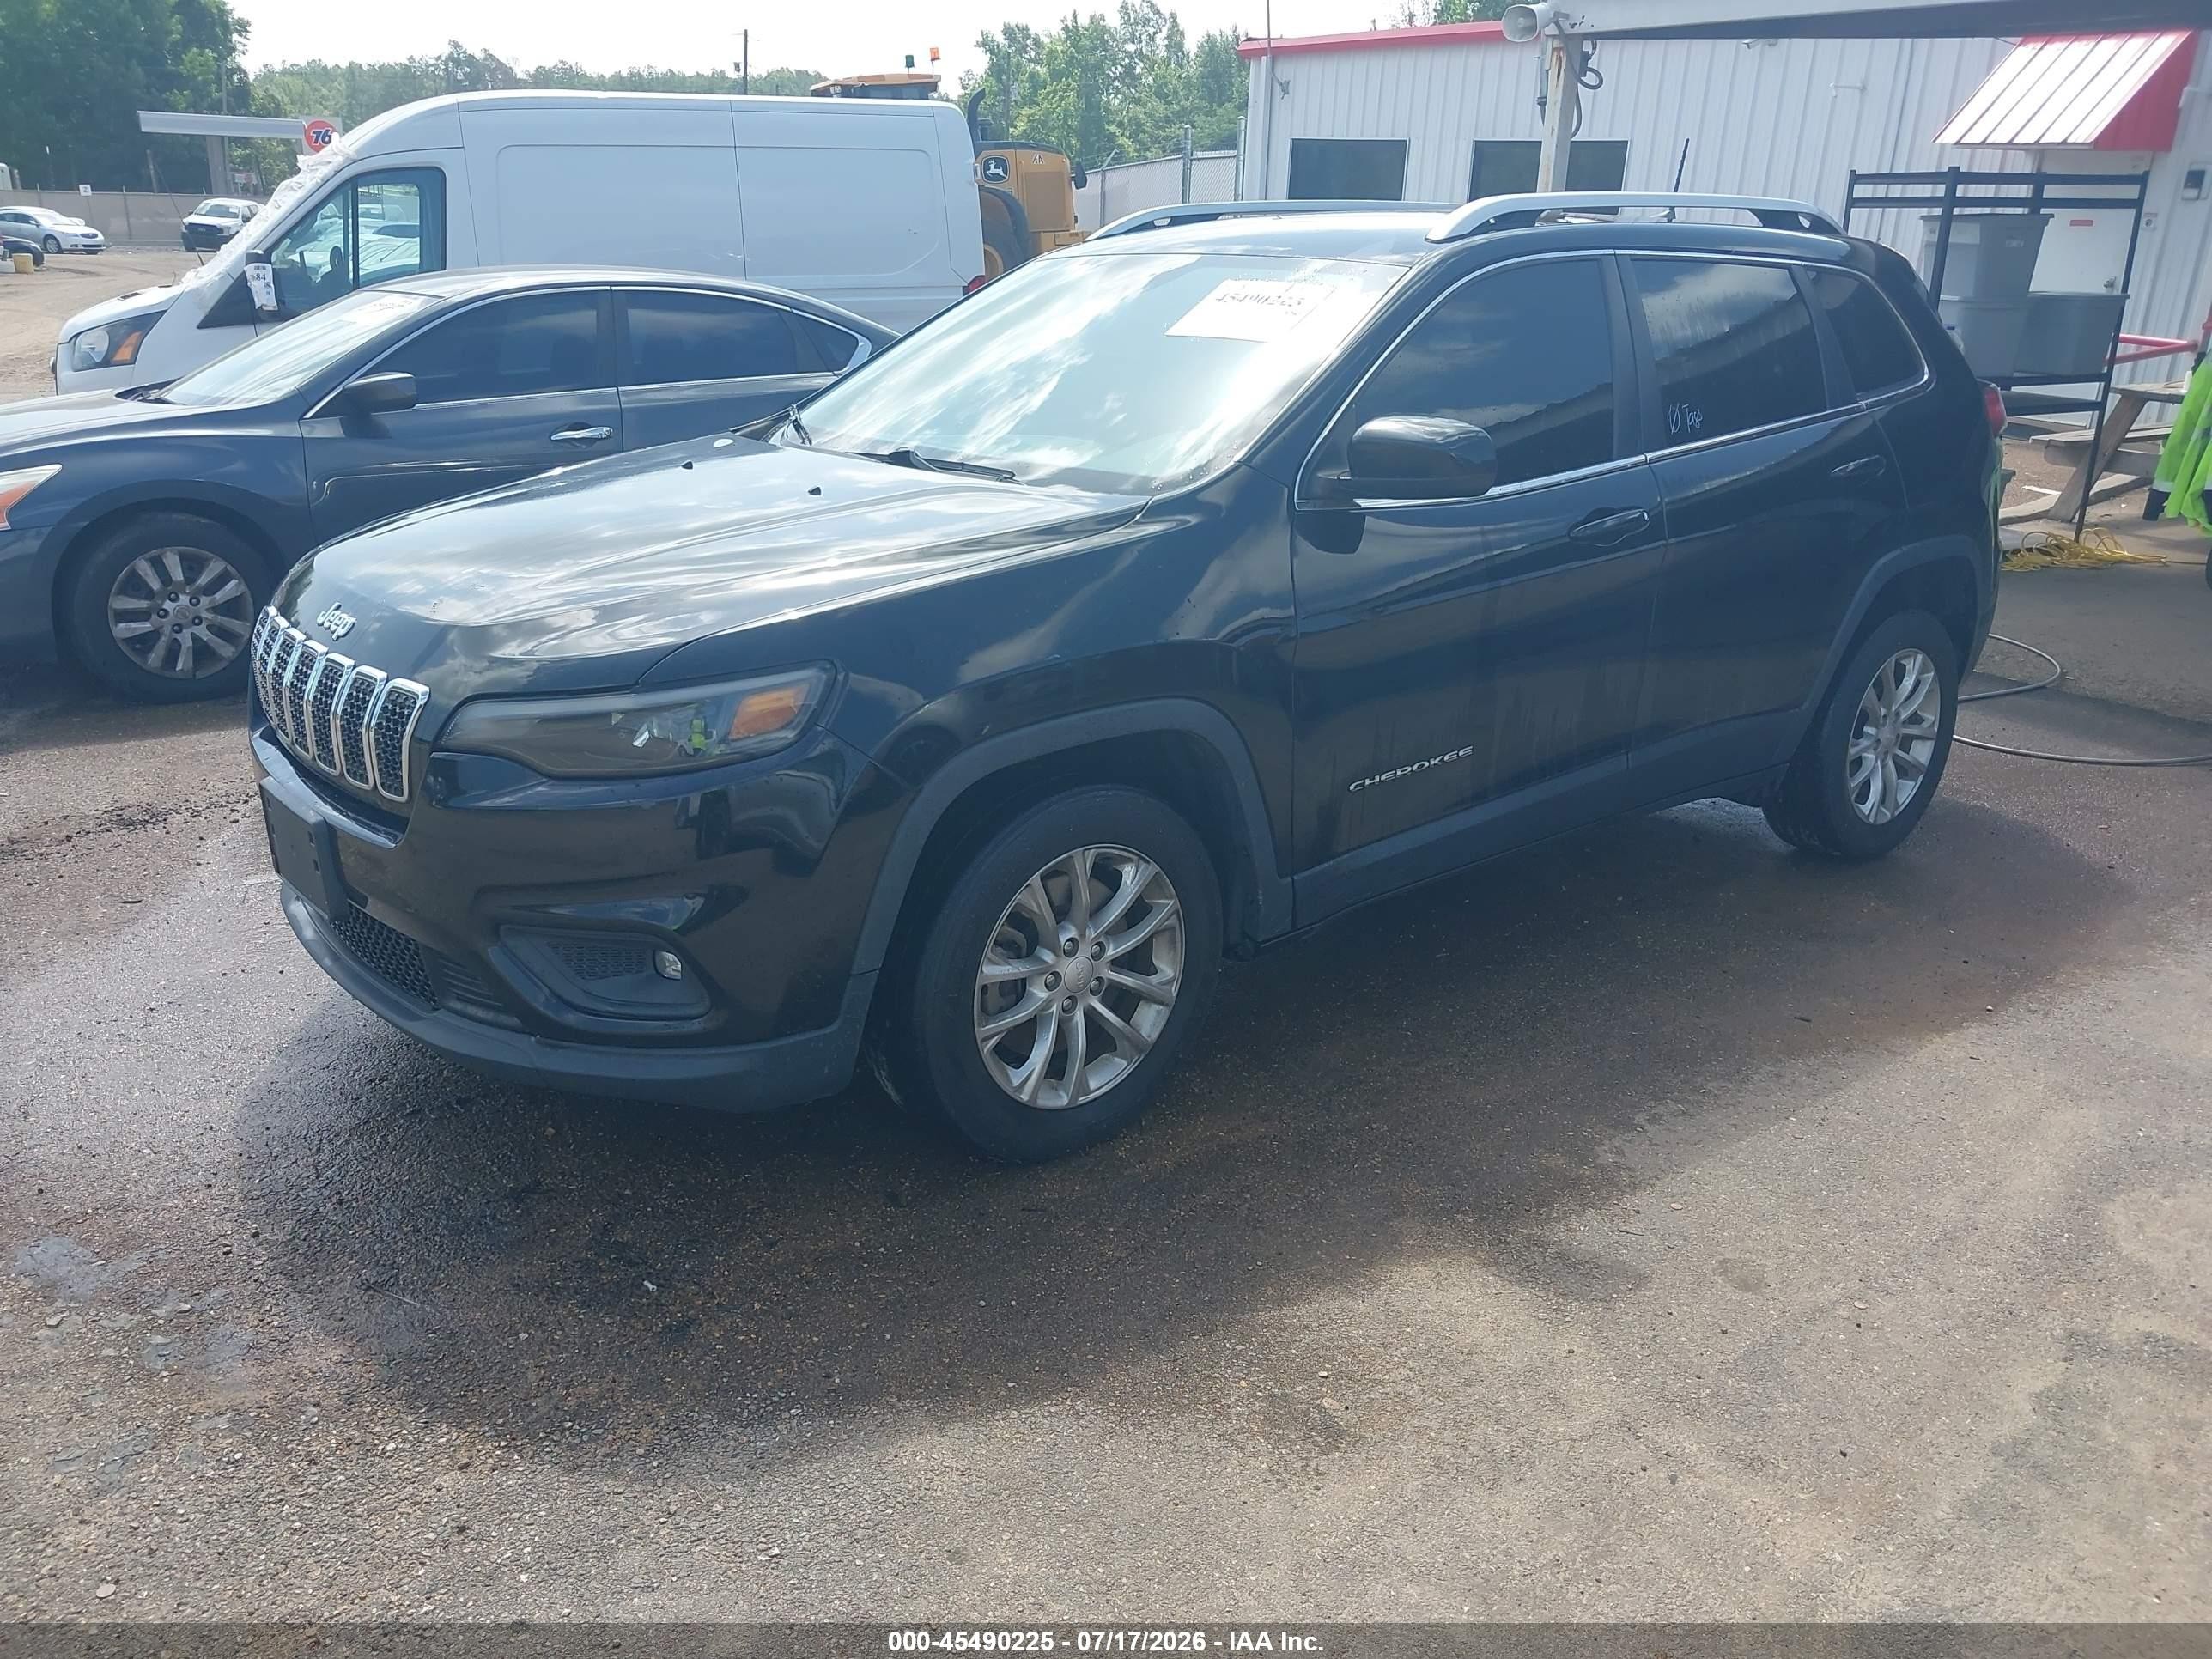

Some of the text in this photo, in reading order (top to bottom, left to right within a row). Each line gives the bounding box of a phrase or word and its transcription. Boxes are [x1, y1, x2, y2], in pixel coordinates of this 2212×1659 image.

[311, 127, 333, 145] 76
[316, 601, 357, 641] Jeep
[1348, 744, 1474, 793] CHEROKEE
